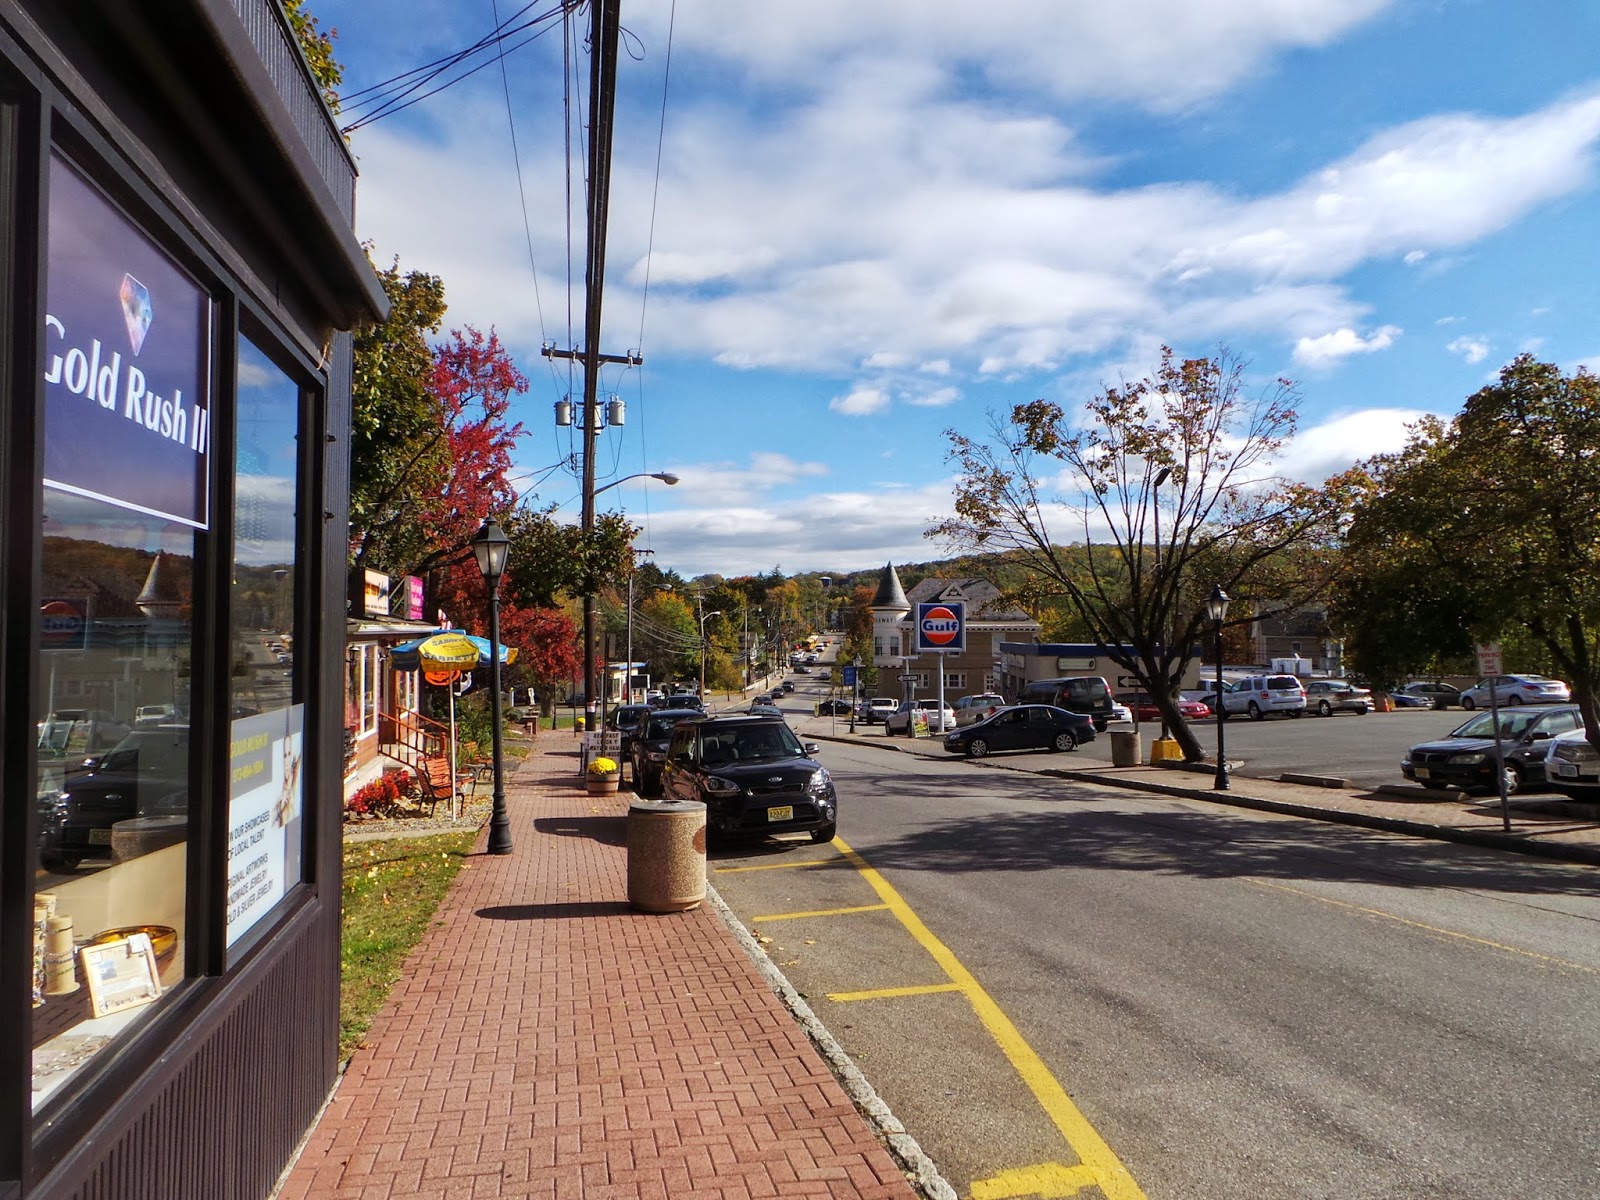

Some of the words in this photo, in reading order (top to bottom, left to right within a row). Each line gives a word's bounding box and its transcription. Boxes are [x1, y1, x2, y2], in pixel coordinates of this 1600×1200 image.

[45, 314, 121, 411] Gold
[125, 365, 187, 445] Rush
[922, 619, 958, 632] Gulf
[244, 810, 270, 833] SHOWCASES
[234, 839, 249, 857] LOCAL
[249, 828, 265, 847] TALENT
